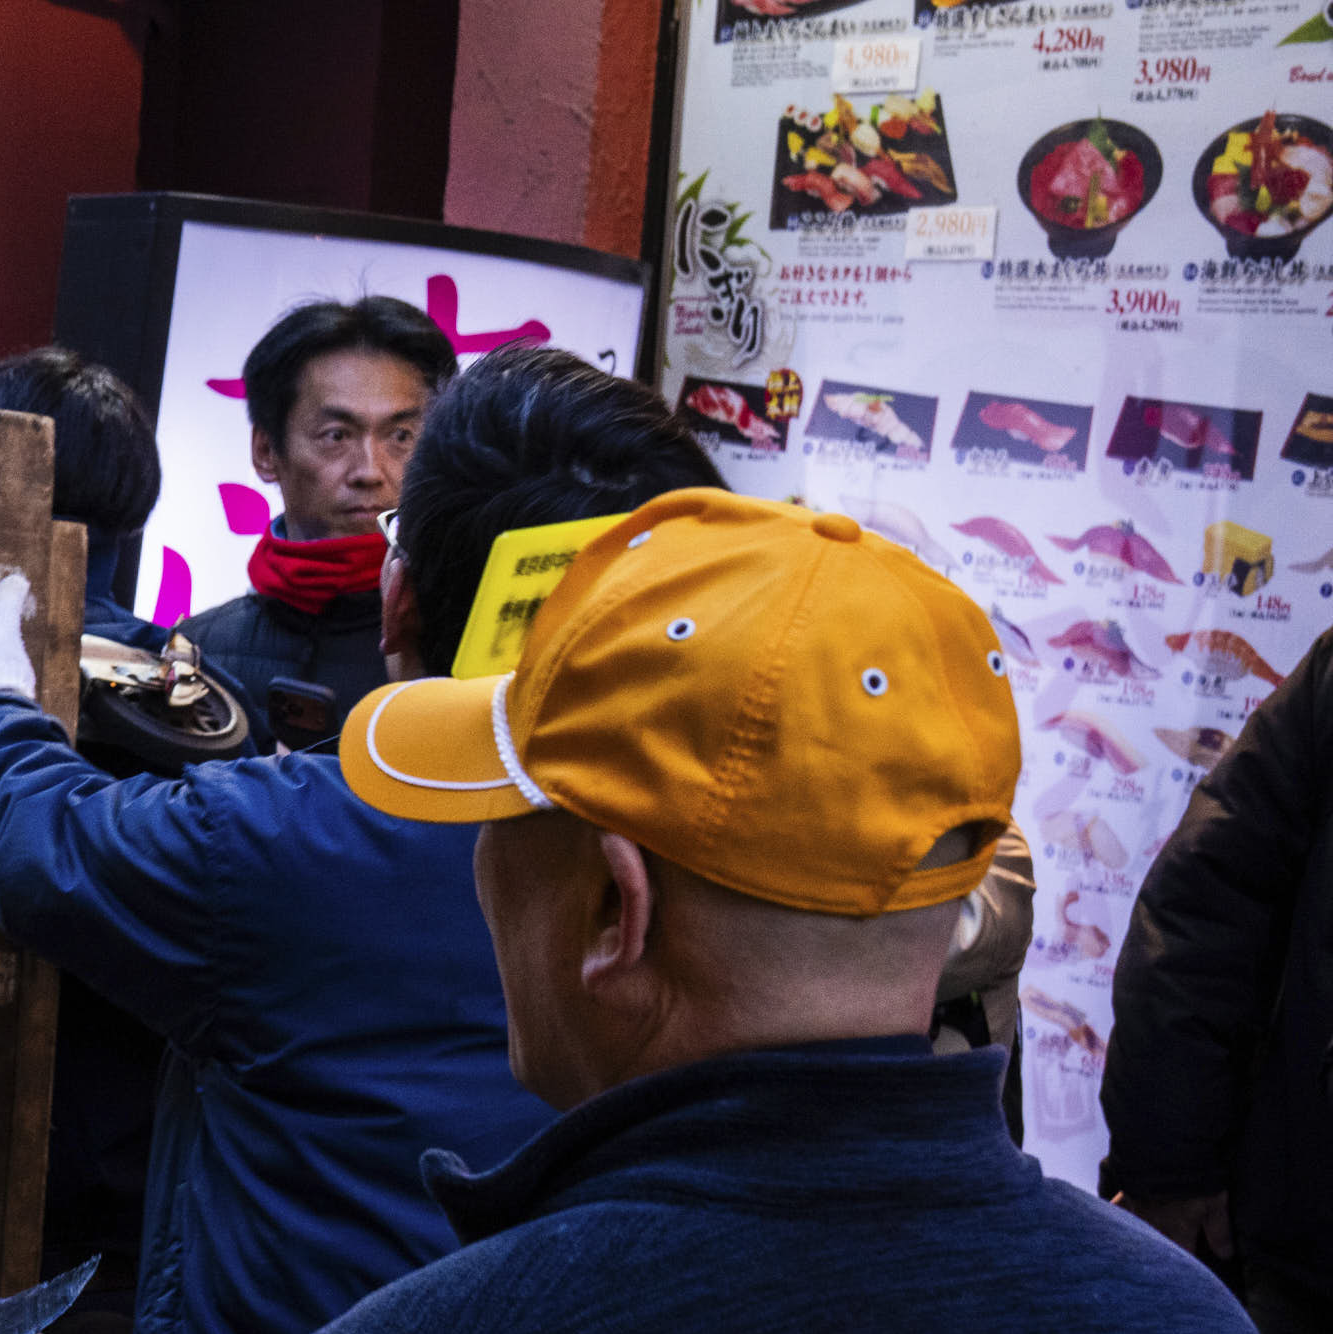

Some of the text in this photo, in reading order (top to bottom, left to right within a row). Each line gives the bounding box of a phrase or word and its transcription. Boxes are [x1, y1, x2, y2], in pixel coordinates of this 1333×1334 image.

[1032, 27, 1105, 54] 4,280円
[1134, 56, 1212, 85] 3,980円
[1105, 288, 1181, 317] 3,900円
